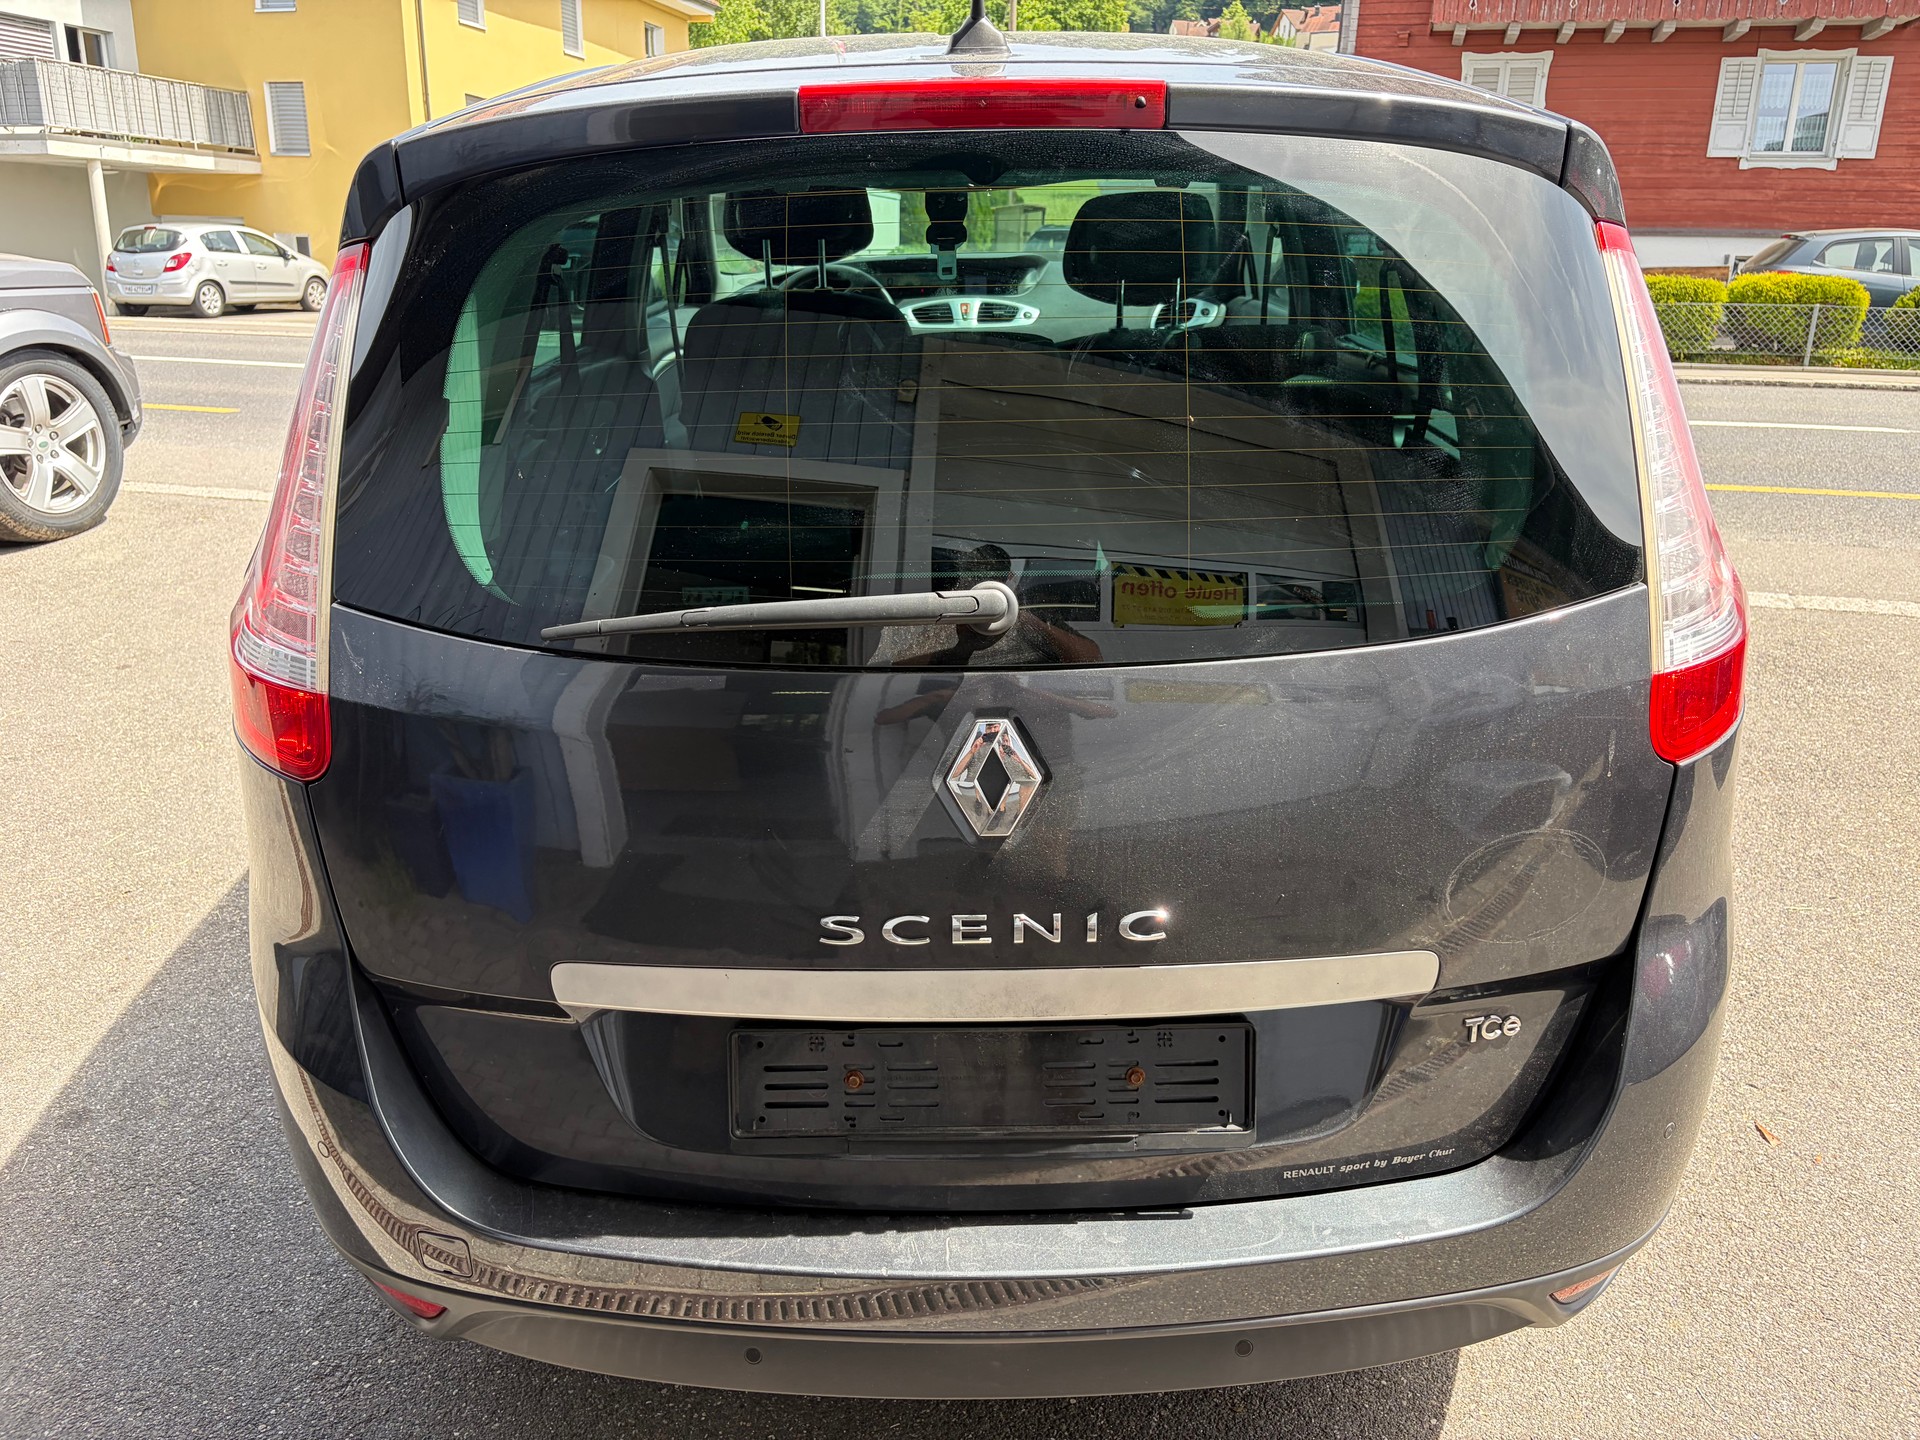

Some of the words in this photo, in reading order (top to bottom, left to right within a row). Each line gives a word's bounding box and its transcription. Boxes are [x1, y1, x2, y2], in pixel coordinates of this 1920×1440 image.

[819, 910, 1167, 945] SCENIC
[1464, 1014, 1522, 1043] TCe
[1283, 1165, 1335, 1179] RENAULT
[1339, 1161, 1370, 1174] sport
[1374, 1159, 1388, 1170] by
[1391, 1153, 1426, 1166] Bayer
[1428, 1147, 1456, 1158] Chur
